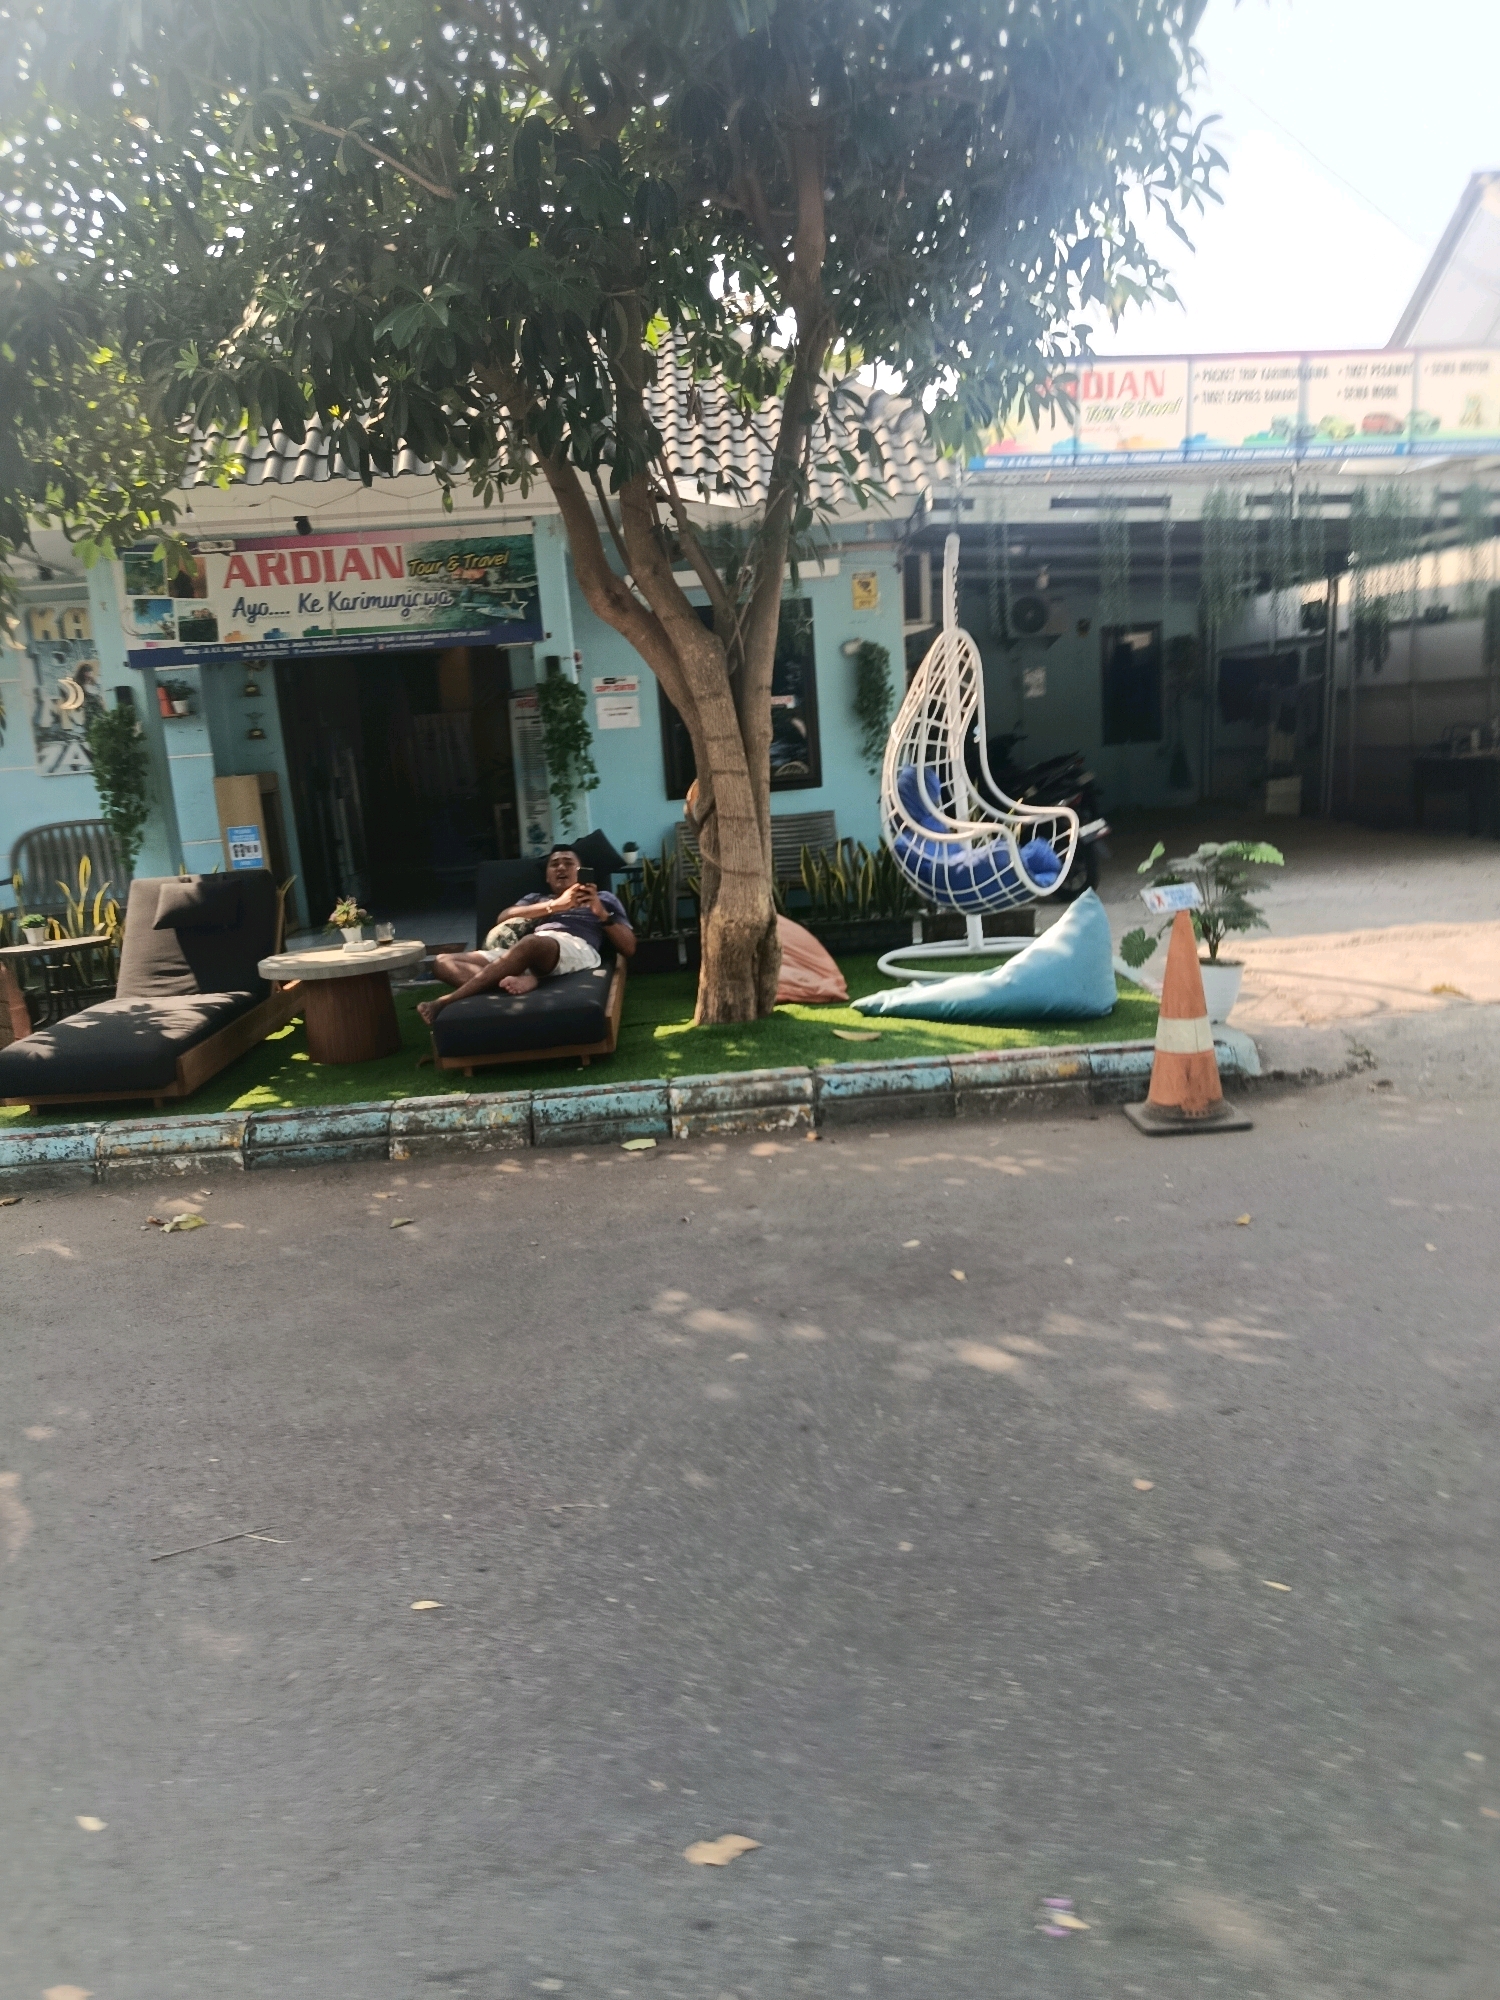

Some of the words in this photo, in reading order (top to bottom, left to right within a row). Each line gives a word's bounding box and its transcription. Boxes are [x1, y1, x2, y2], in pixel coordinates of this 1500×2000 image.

[1040, 369, 1166, 400] DIAN
[223, 545, 405, 589] ARDIAN
[408, 558, 442, 577] Tour
[446, 553, 461, 572] &
[463, 551, 510, 570] Travel
[298, 592, 324, 614] Ke
